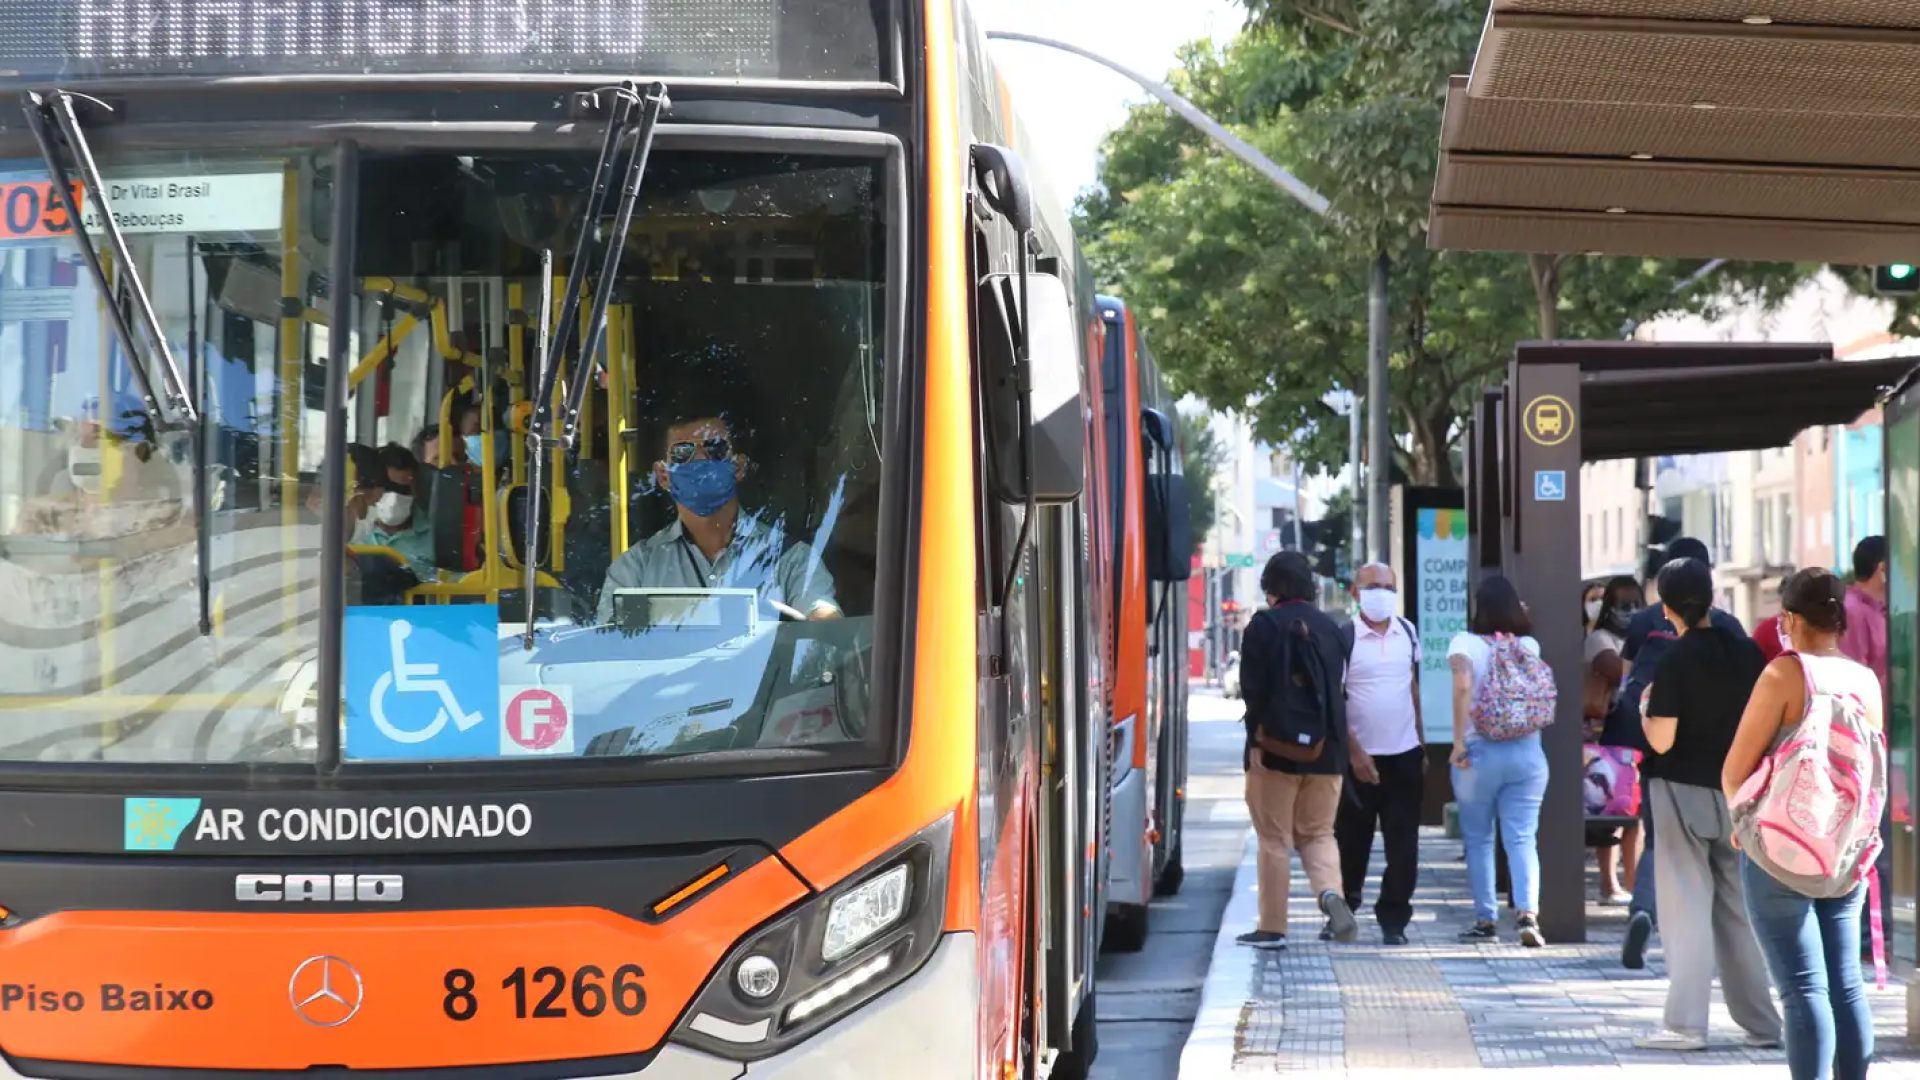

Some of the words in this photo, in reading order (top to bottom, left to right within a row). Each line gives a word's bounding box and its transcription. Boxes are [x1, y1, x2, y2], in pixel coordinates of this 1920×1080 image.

[111, 185, 128, 201] Dr
[133, 184, 163, 200] Vital
[168, 182, 210, 198] Brasil
[0, 184, 77, 234] 05
[1424, 578, 1445, 593] DO
[520, 699, 553, 740] F
[195, 808, 245, 841] AR
[258, 803, 532, 841] CONDICIONADO
[235, 874, 403, 902] CAIO
[1, 983, 85, 1012] Piso
[101, 983, 213, 1012] Baixo
[443, 968, 478, 1021] 8
[502, 964, 647, 1019] 1266
